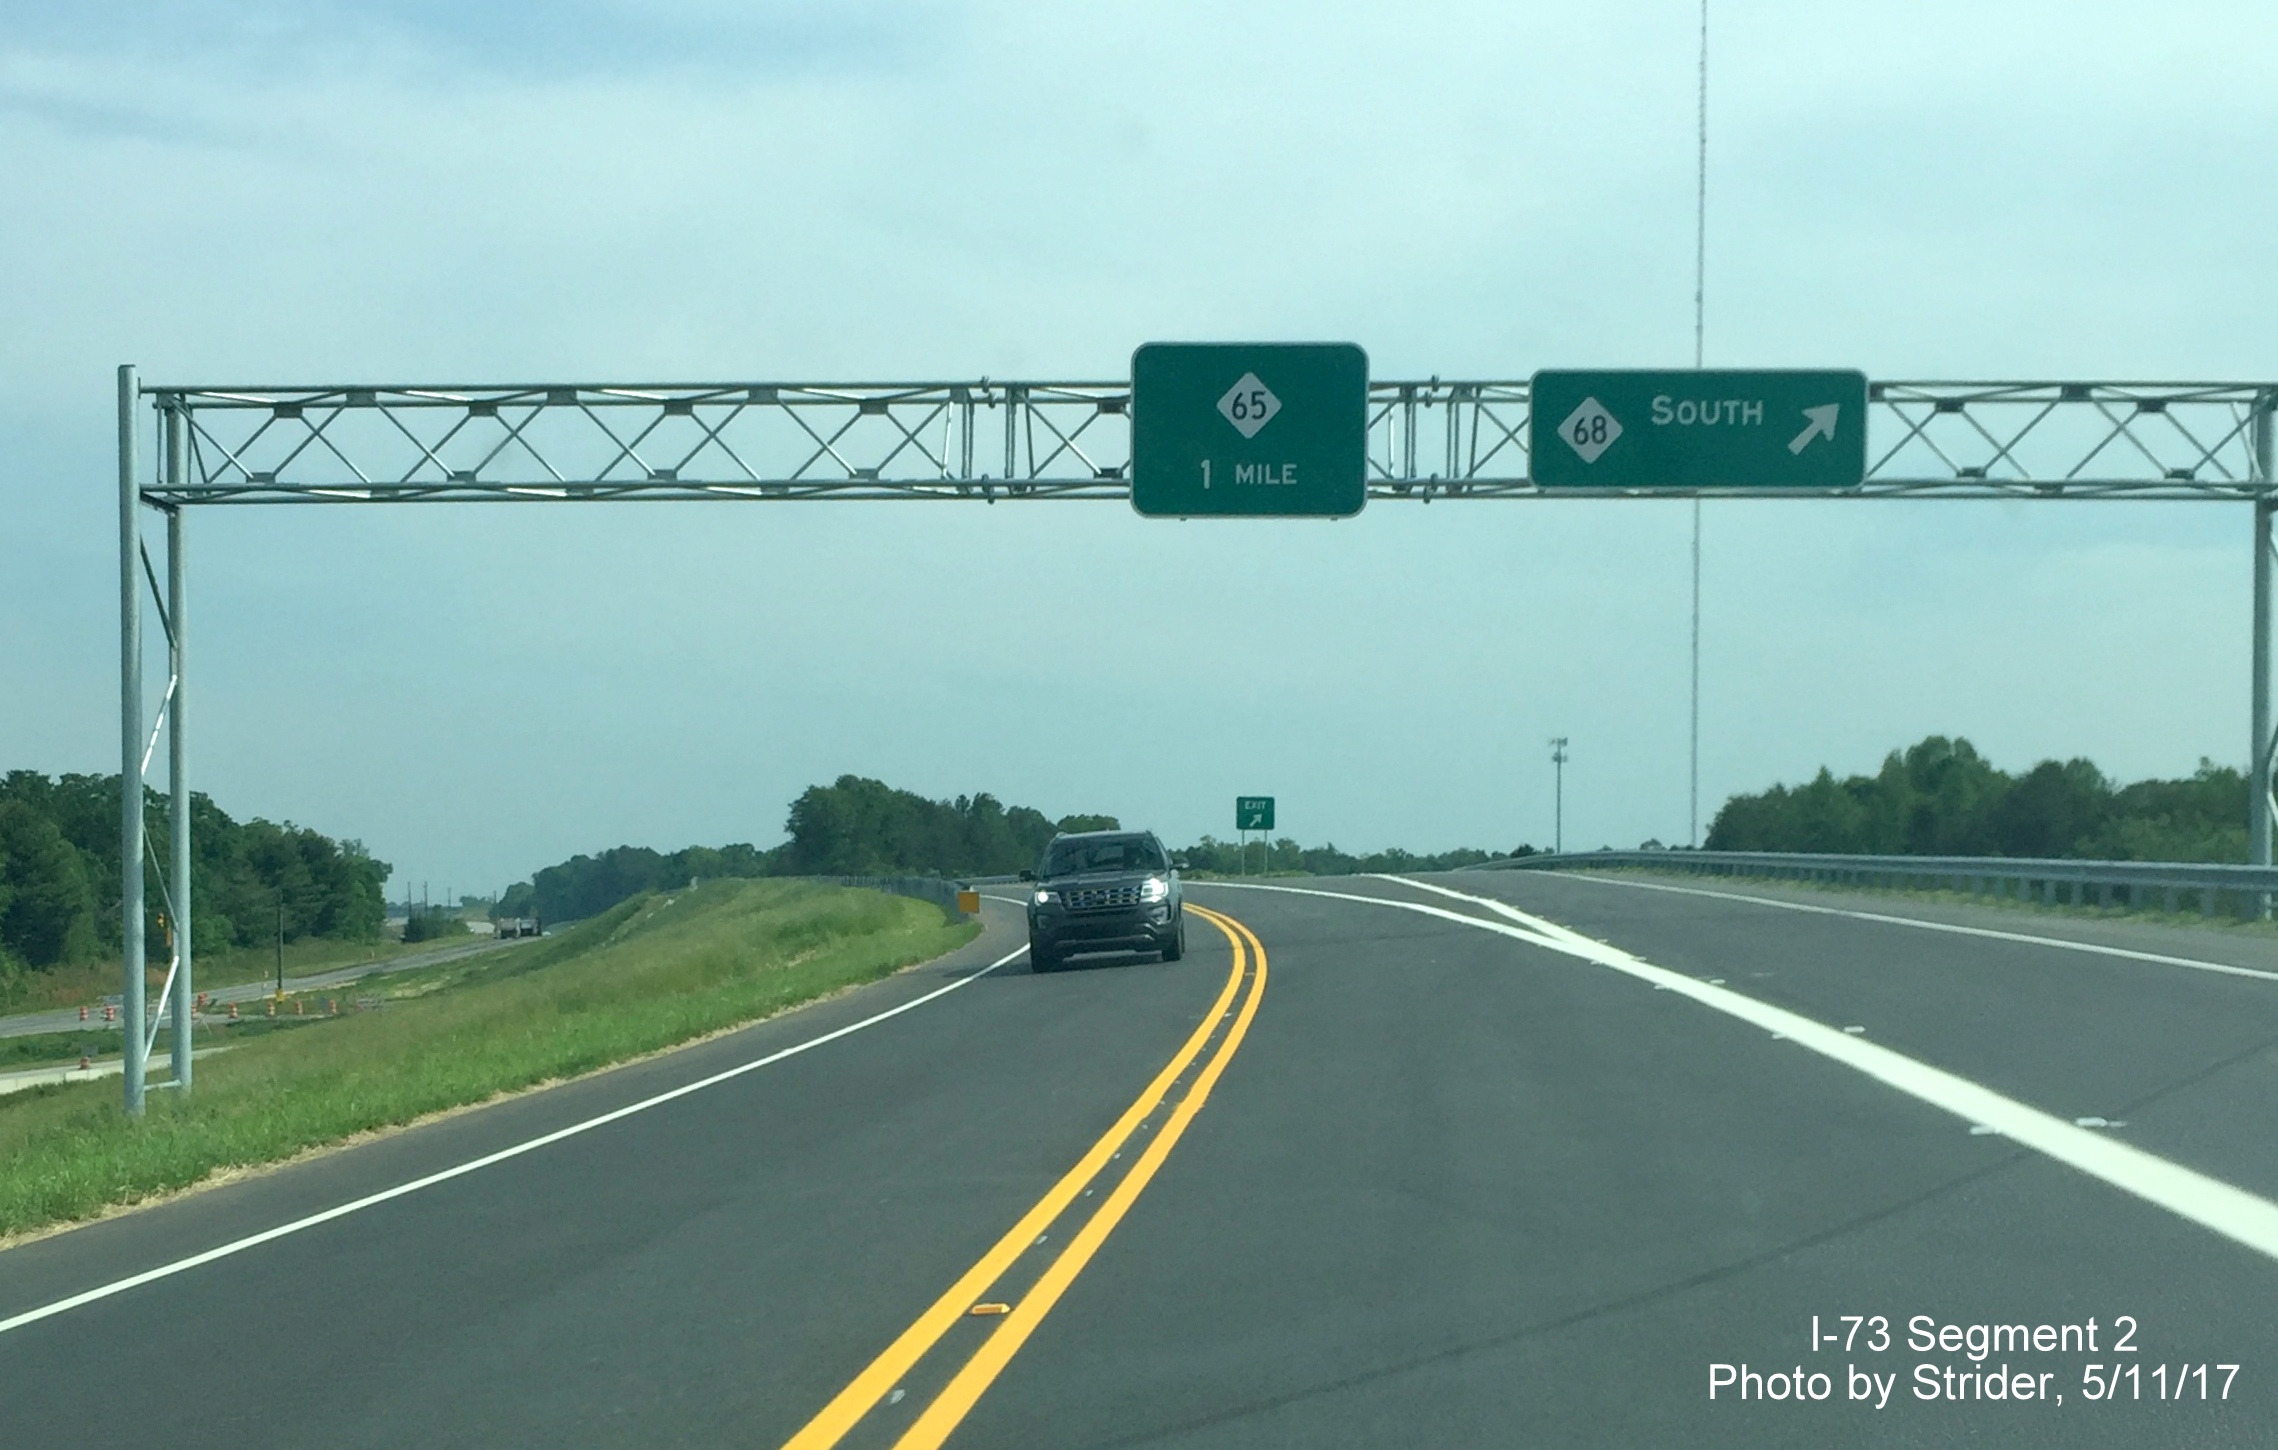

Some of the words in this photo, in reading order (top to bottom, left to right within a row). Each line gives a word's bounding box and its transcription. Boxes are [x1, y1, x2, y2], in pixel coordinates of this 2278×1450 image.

[1231, 390, 1268, 420] 65
[1573, 414, 1608, 446] 68
[1650, 395, 1764, 426] SOUTH
[1201, 459, 1211, 489] 1
[1235, 463, 1298, 485] MILE
[1245, 800, 1267, 810] EXIT
